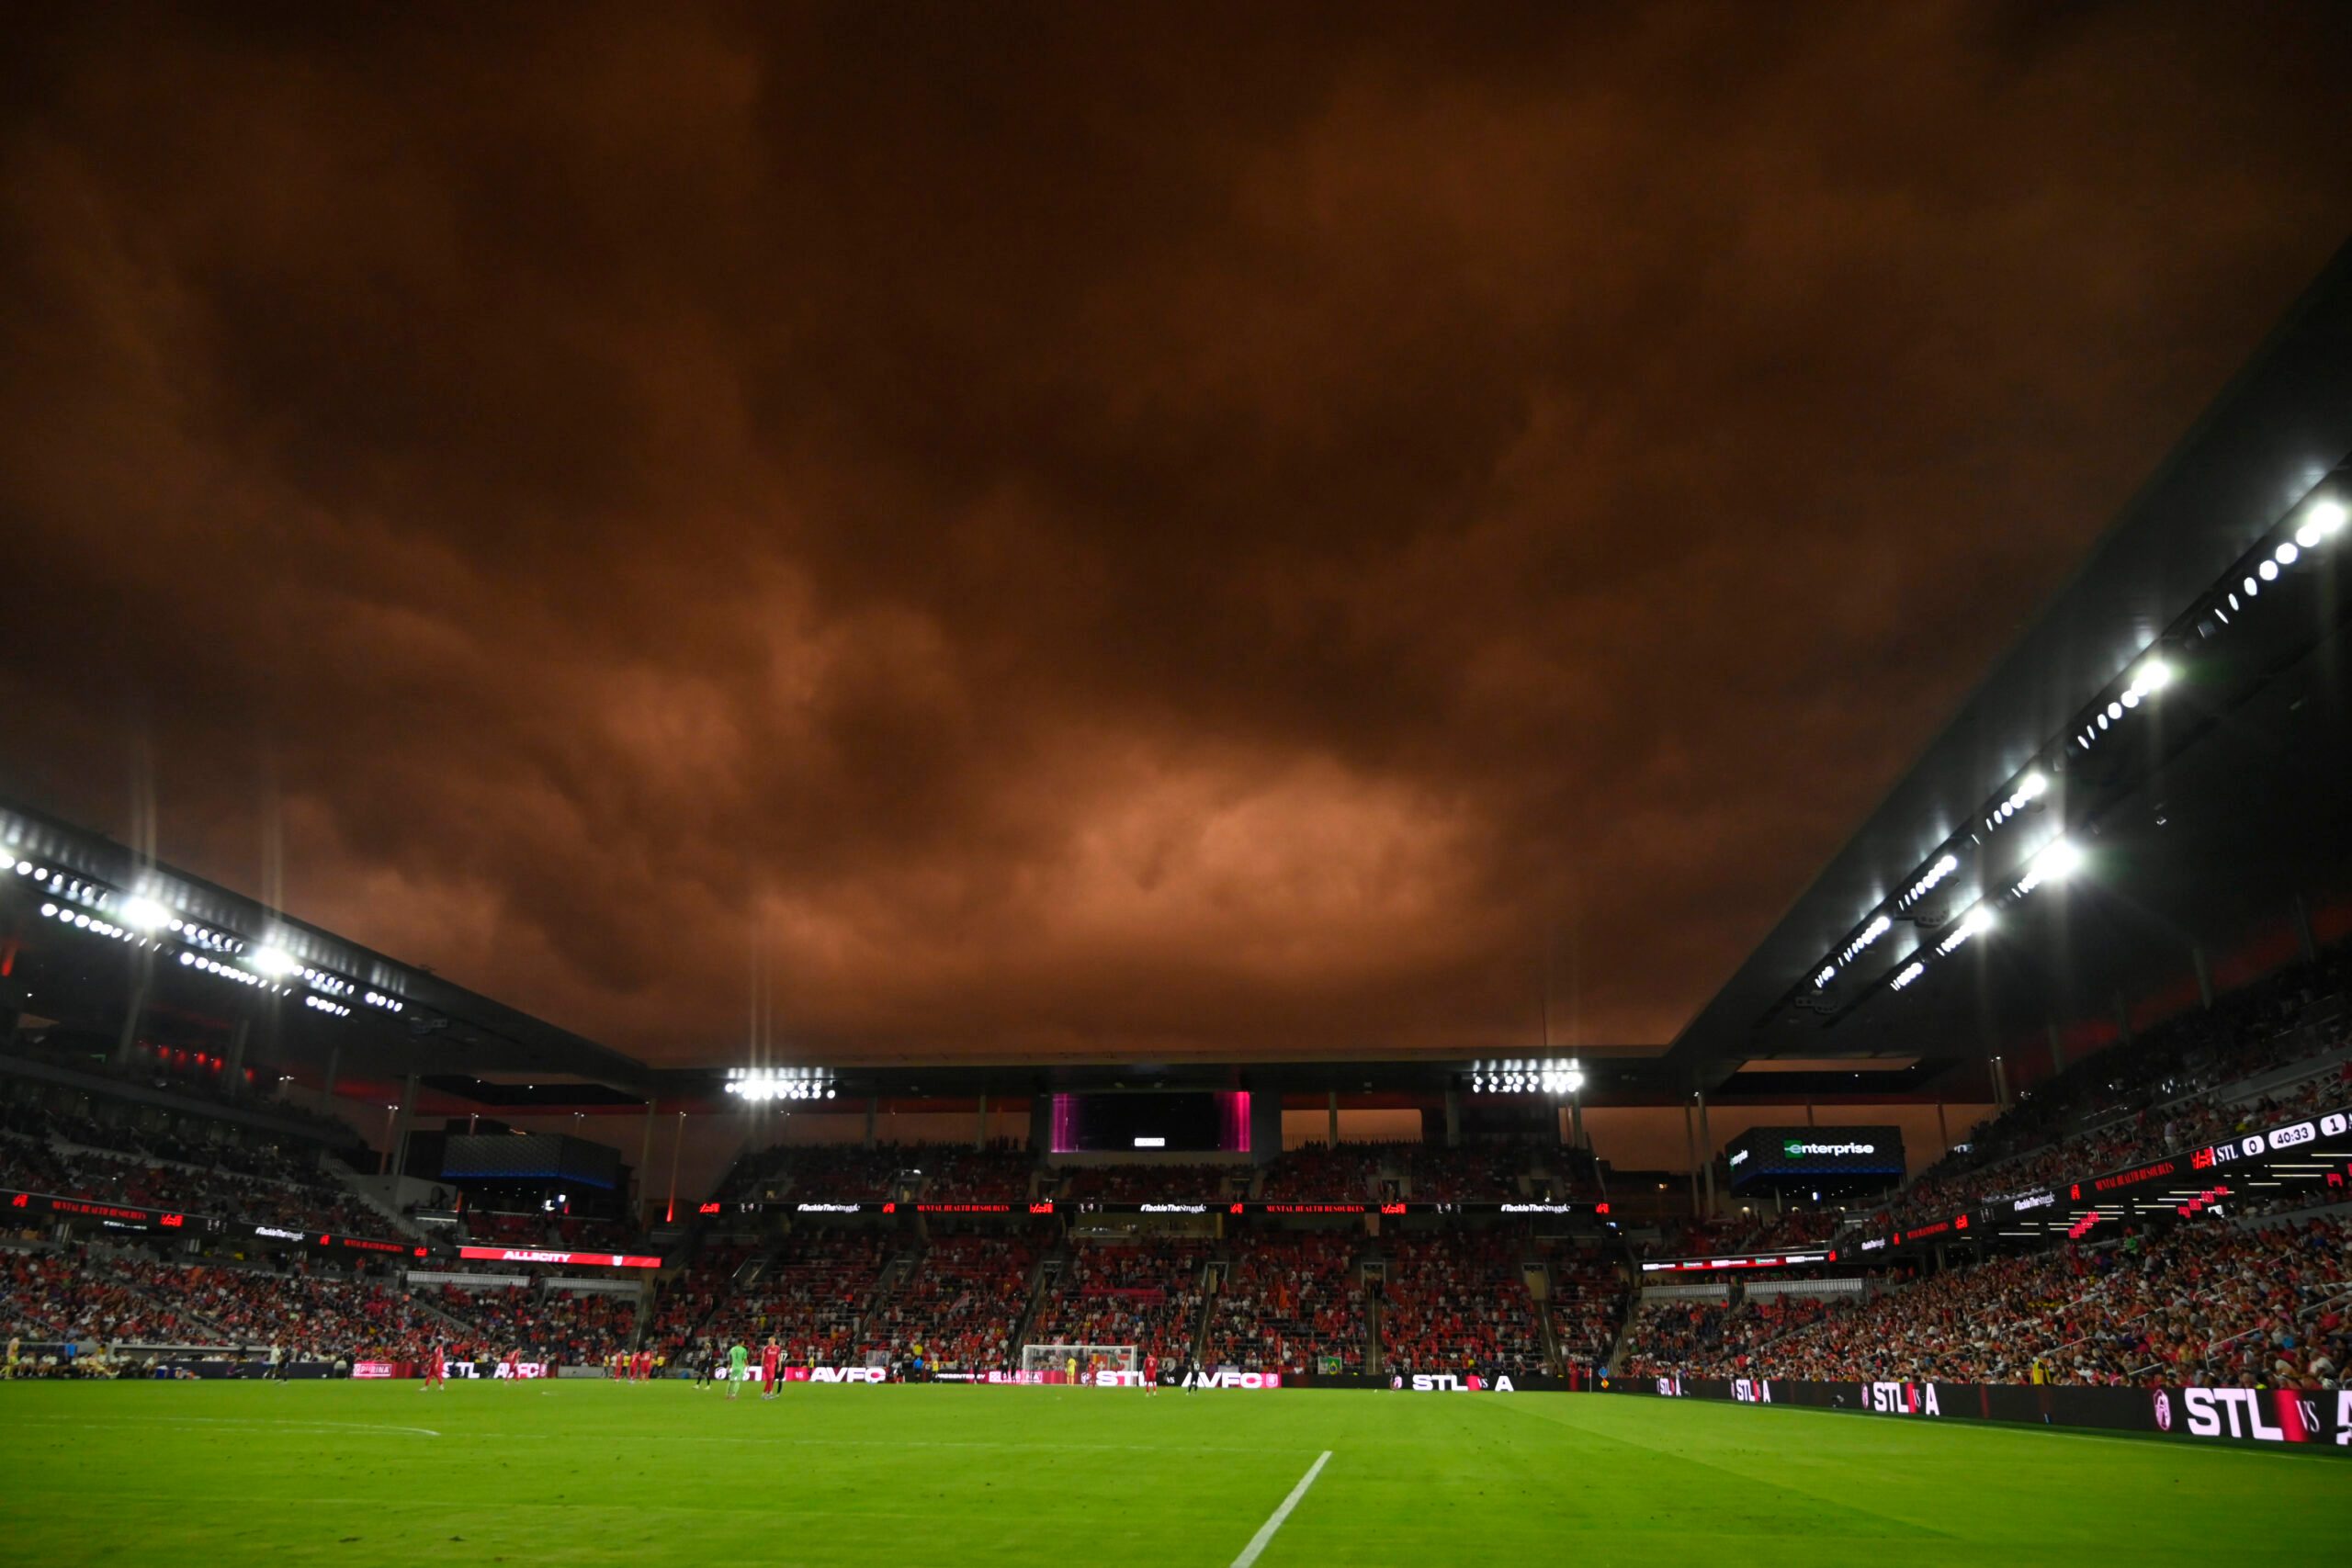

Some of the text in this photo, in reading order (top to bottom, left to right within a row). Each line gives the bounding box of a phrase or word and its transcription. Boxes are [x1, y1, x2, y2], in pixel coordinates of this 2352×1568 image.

[1784, 1142, 1874, 1156] enterprise
[2216, 1145, 2239, 1163] STL
[2248, 1140, 2257, 1154] 0
[2277, 1127, 2309, 1145] 40:33
[2329, 1118, 2340, 1132] 1
[1140, 1203, 1206, 1213] #TackleTheStruggle
[1266, 1204, 1364, 1213] MENTAL HEALTH RESOURCES
[1500, 1203, 1570, 1213] #TackleTheStruggle
[359, 1364, 390, 1375] PURINA
[809, 1366, 887, 1383] AVFC
[1166, 1376, 1176, 1384] VS
[1412, 1374, 1514, 1392] STL VS A
[1659, 1378, 1681, 1396] STL A
[1736, 1379, 1756, 1402] STL
[1762, 1380, 1771, 1403] A
[1873, 1382, 1909, 1414] STL
[1926, 1382, 1940, 1416] A
[2185, 1387, 2284, 1441] STL
[2295, 1400, 2320, 1433] VS
